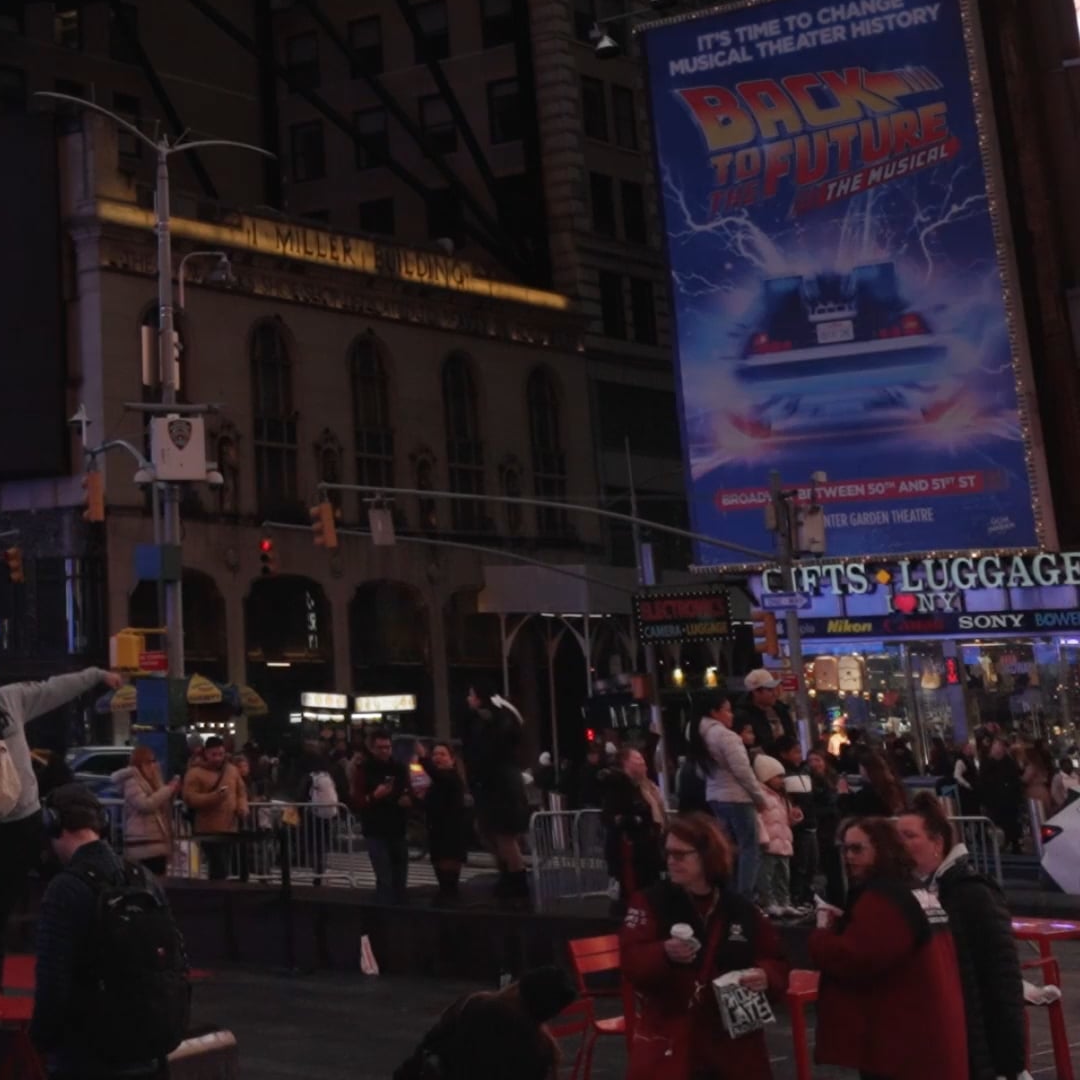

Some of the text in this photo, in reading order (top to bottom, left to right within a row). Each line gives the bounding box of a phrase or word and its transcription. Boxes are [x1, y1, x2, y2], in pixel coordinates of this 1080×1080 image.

[669, 4, 941, 77] MUSICAL THEATER HISTORY
[697, 30, 732, 52] IT'S
[735, 21, 781, 46] TIME
[787, 12, 813, 32] TO
[677, 66, 923, 151] BACK
[711, 102, 949, 196] TO FUTURE
[707, 145, 949, 219] THE THE MUSICAL
[275, 227, 356, 265] MILLER
[376, 246, 465, 285] BUILDING
[898, 478, 929, 493] AND
[958, 475, 977, 489] ST
[849, 510, 890, 526] GARDEN
[891, 507, 935, 524] THEATRE
[898, 552, 1080, 593] LUGGAGE
[917, 591, 962, 614] NY
[827, 619, 873, 634] Nikon
[958, 614, 1024, 630] SONY
